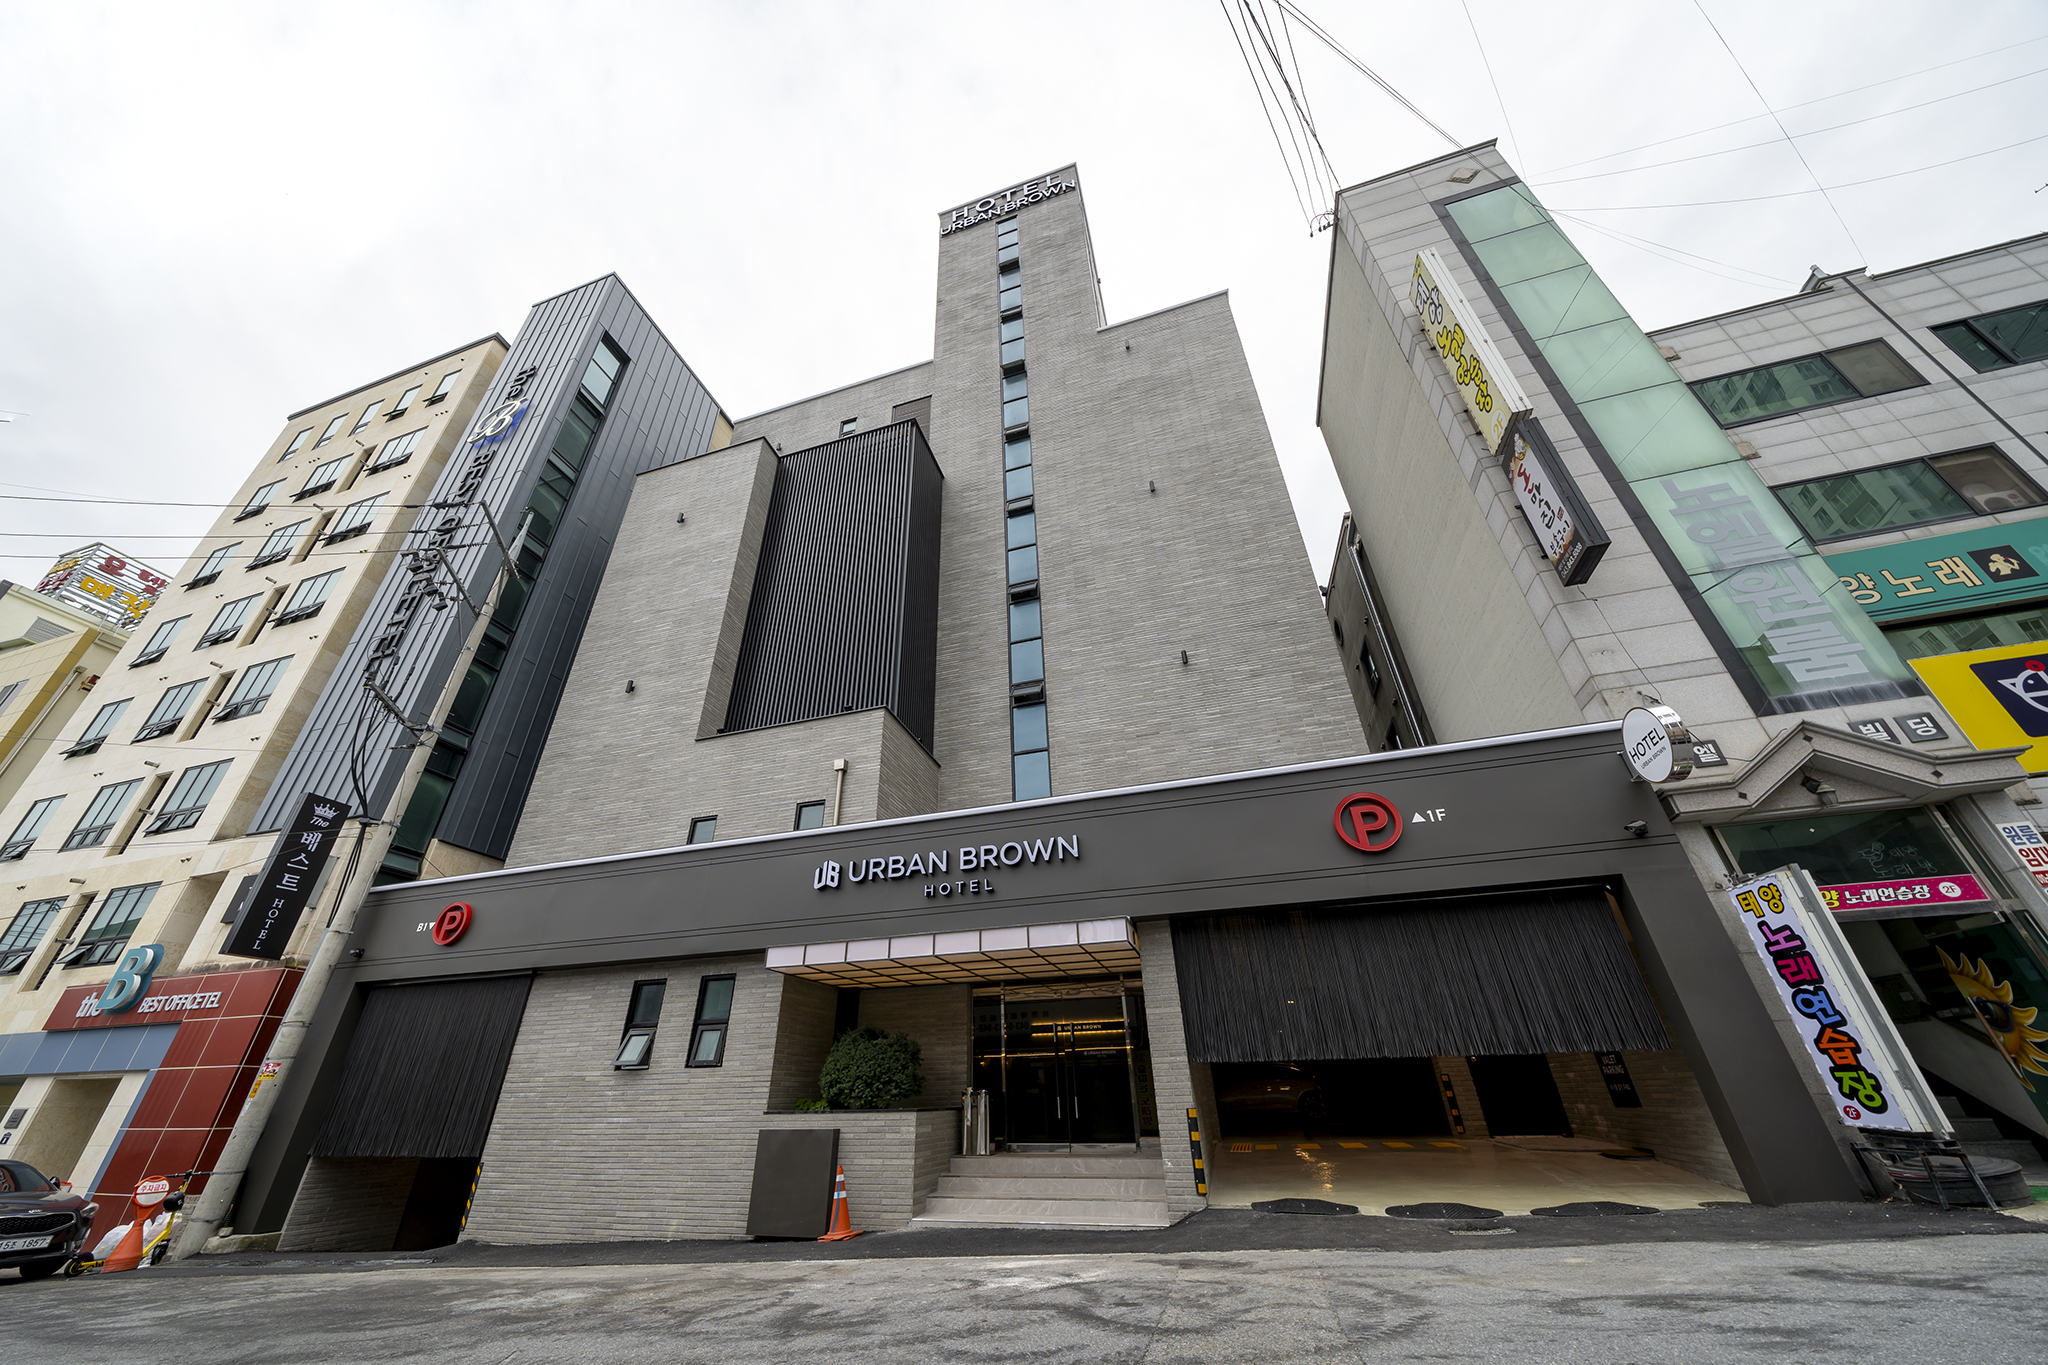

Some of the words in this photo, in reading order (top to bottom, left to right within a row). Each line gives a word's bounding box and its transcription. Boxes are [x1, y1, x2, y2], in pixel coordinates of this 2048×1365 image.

[940, 206, 1001, 235] URBAN
[1004, 179, 1076, 212] BROWN
[952, 175, 1062, 222] HOTEL
[1416, 274, 1443, 325] 태양
[1437, 323, 1493, 413] 노래연습장
[1493, 412, 1505, 440] 2F
[505, 365, 538, 399] the
[80, 576, 150, 619] 매직
[1629, 728, 1665, 763] HOTEL
[1641, 757, 1654, 769] URBAN
[1652, 746, 1667, 761] BROWN
[310, 816, 330, 828] The
[1427, 808, 1446, 823] 1F
[2002, 825, 2043, 845] 원룸
[276, 831, 322, 892] 베스트
[848, 850, 949, 882] URBAN
[959, 834, 1080, 871] BROWN
[924, 878, 994, 897] HOTEL
[1736, 883, 1785, 918] 태양
[1845, 884, 1931, 905] 노래연습장
[1941, 884, 1957, 895] 2F
[253, 898, 285, 950] HOTEL
[76, 992, 101, 1018] the
[97, 944, 164, 1015] B
[137, 996, 167, 1014] BEST
[164, 991, 223, 1012] OFFICETEL
[1759, 922, 1886, 1112] 노래연습장
[141, 1183, 167, 1192] 주차금지
